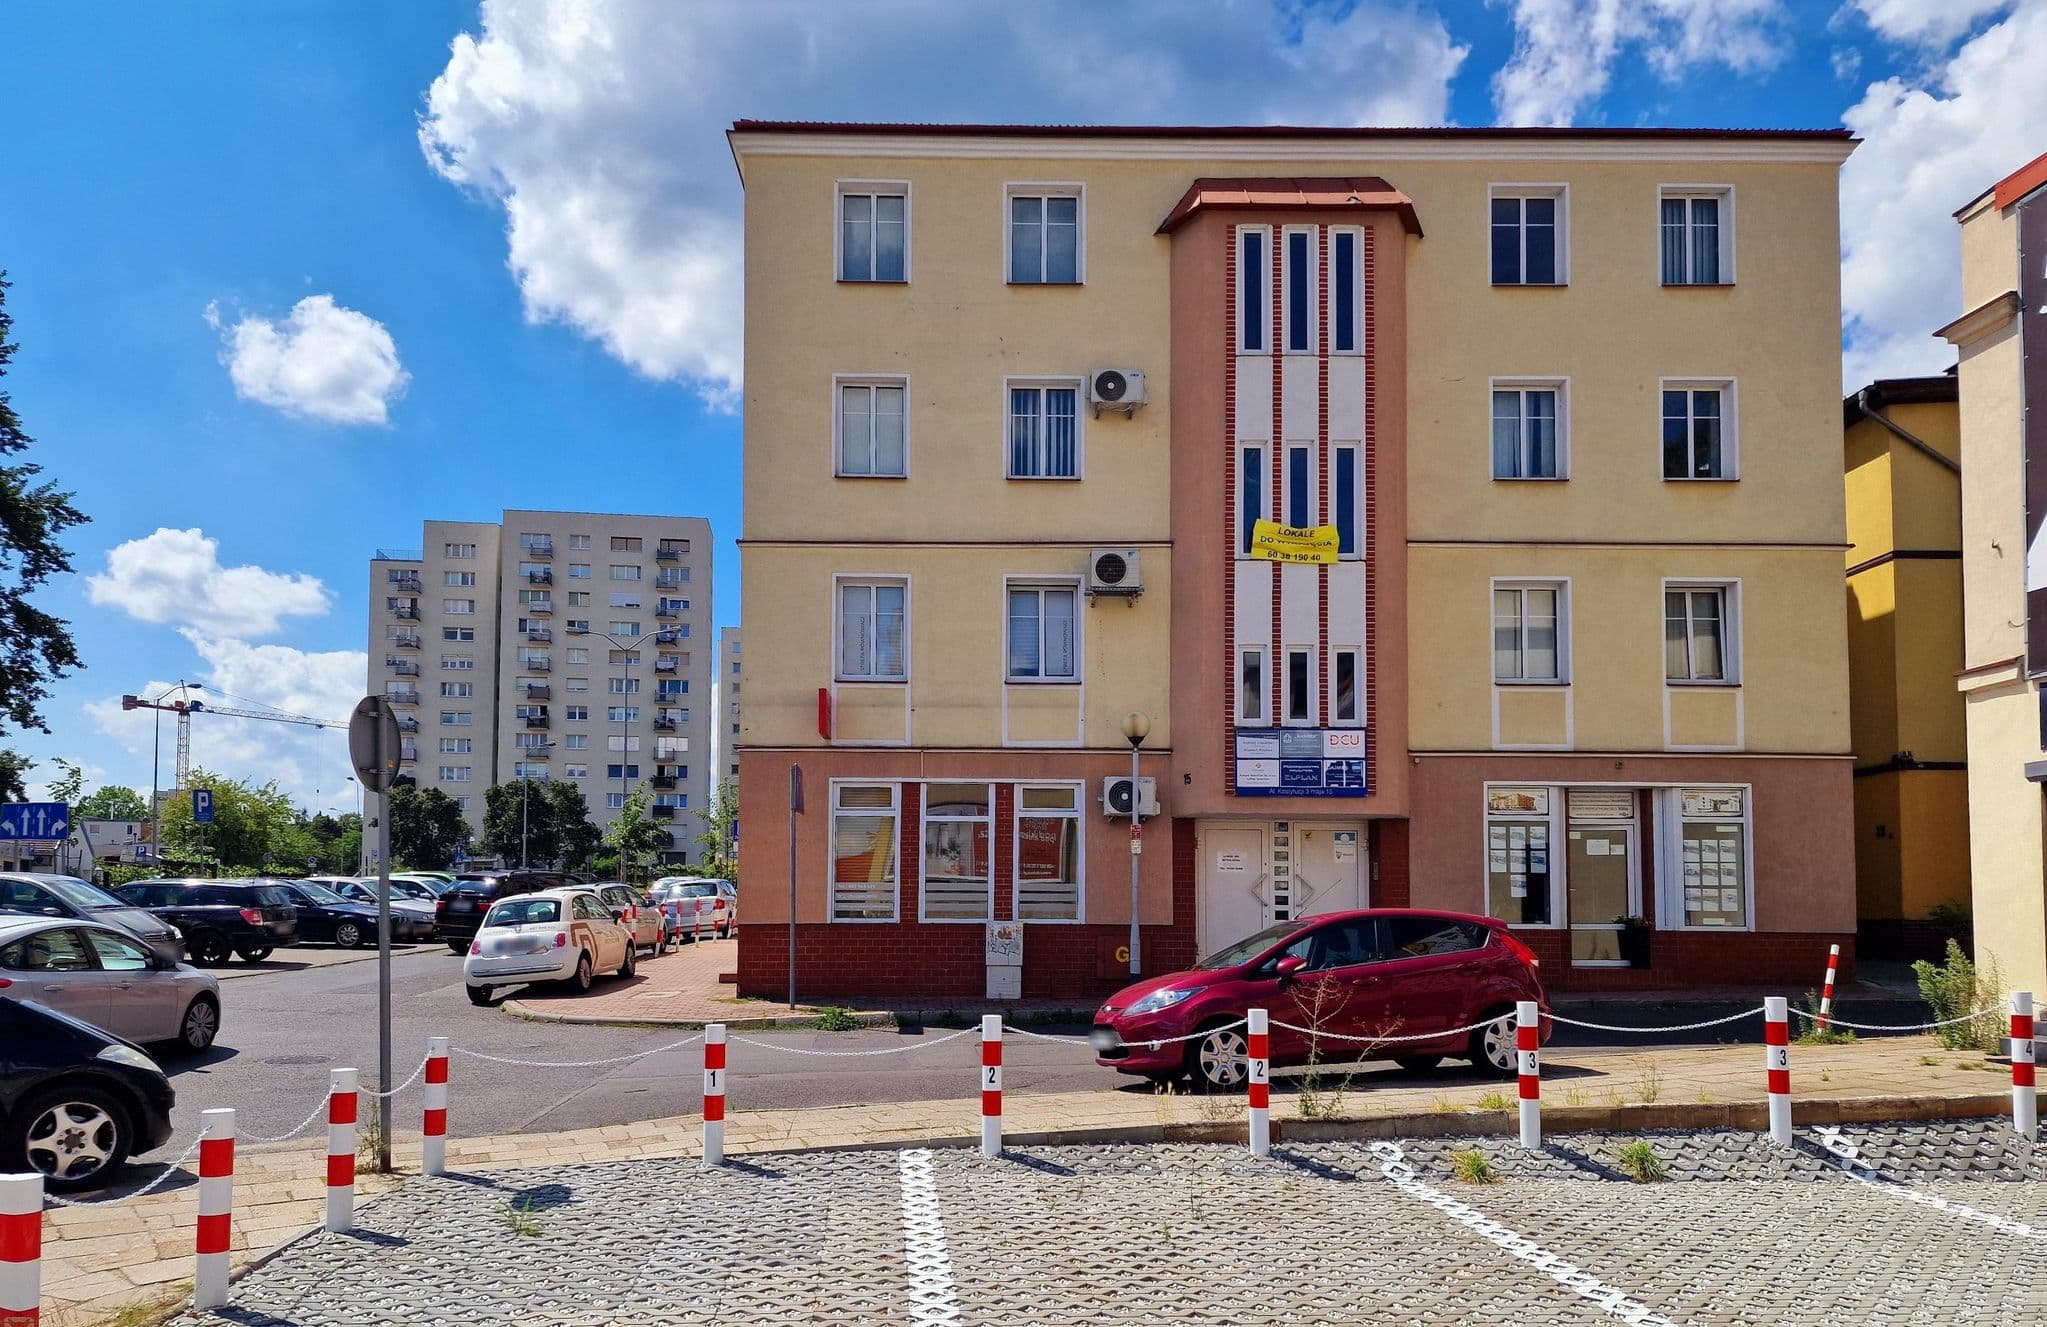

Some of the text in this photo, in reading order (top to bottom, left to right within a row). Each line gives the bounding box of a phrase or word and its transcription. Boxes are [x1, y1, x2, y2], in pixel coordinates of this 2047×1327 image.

[1278, 527, 1315, 538] LOKALE
[1293, 553, 1309, 561] 190
[1330, 734, 1360, 746] DCU
[1183, 773, 1192, 786] 15
[198, 792, 209, 812] P
[138, 846, 145, 854] P
[1116, 946, 1130, 963] G
[2025, 1040, 2033, 1057] 4
[1529, 1052, 1536, 1069] 3
[1780, 1049, 1787, 1066] 3
[988, 1066, 996, 1084] 2
[1256, 1060, 1264, 1077] 2
[710, 1070, 716, 1087] 1
